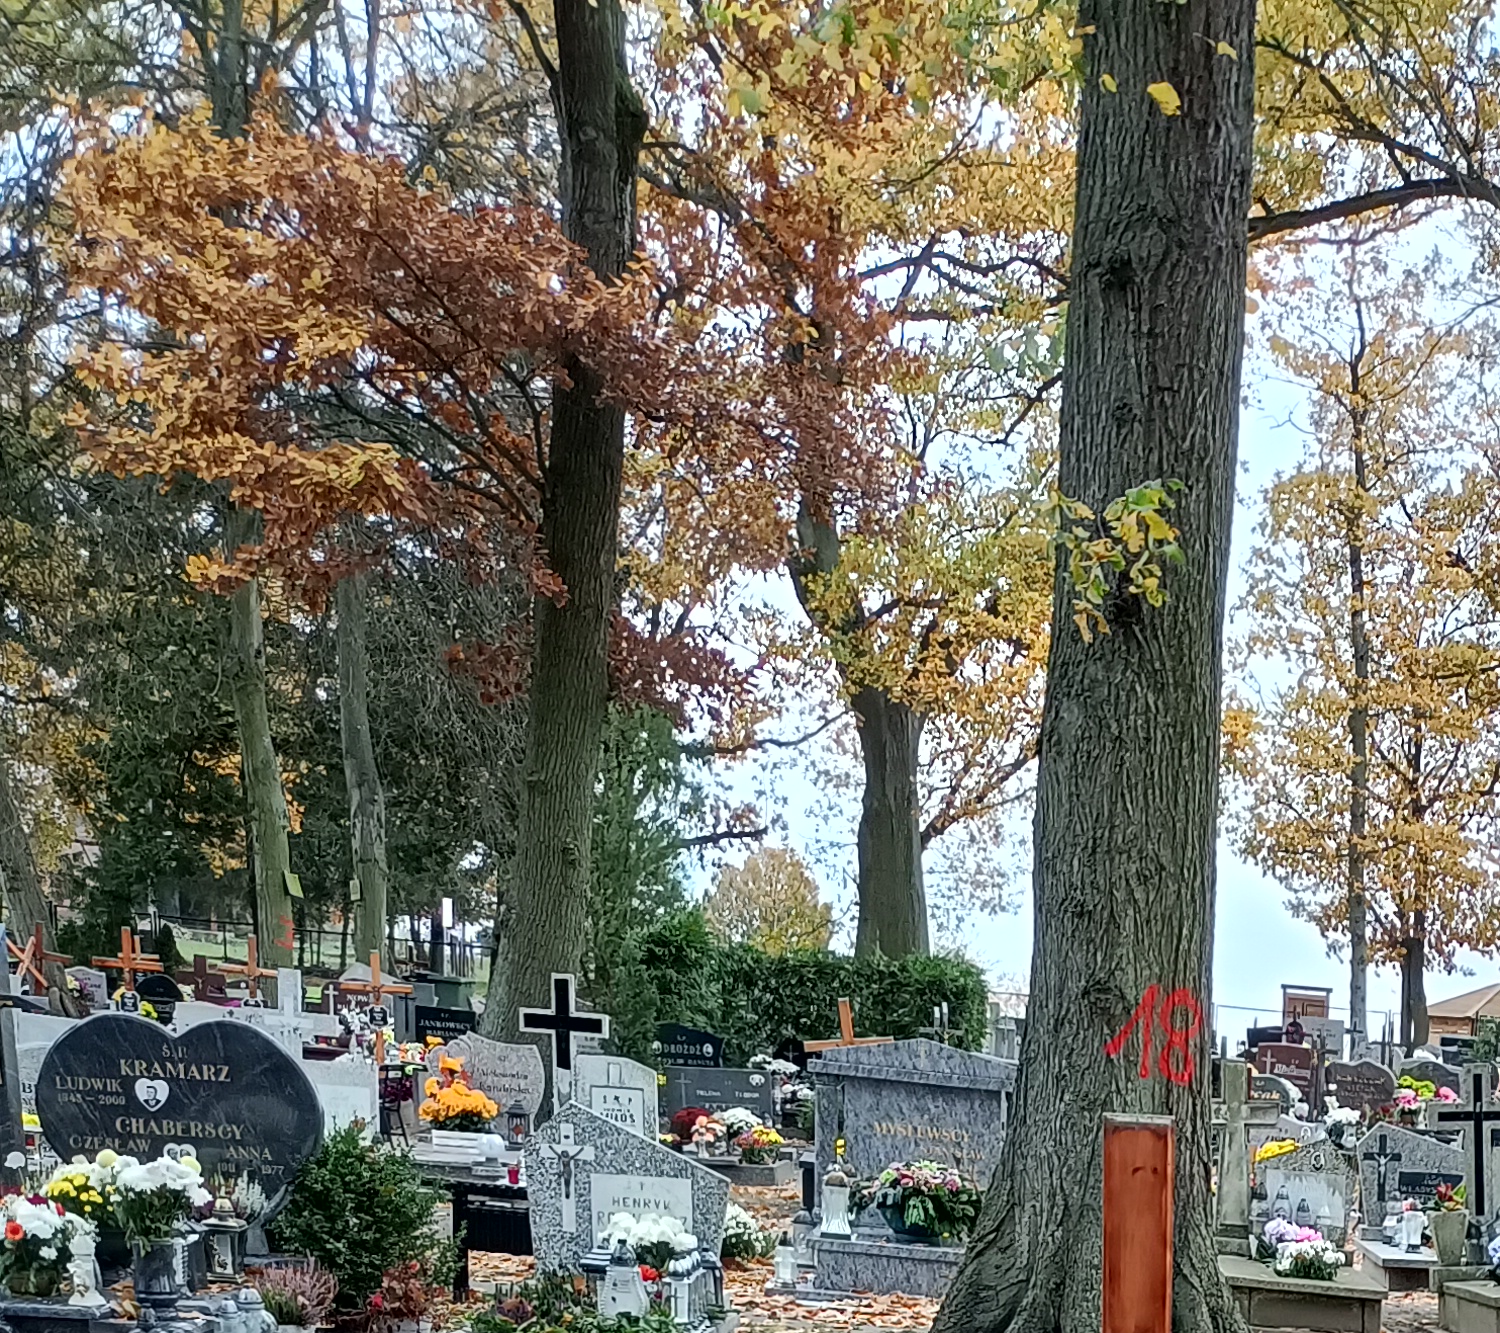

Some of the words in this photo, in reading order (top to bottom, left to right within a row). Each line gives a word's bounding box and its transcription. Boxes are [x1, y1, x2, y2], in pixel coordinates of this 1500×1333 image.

[1103, 983, 1201, 1086] 18
[120, 1058, 231, 1083] KRAMARZ
[55, 1074, 123, 1093] LUDWIK
[115, 1116, 244, 1141] CHABERSCY
[69, 1134, 152, 1153] CZESŁAW
[226, 1144, 273, 1162] ANNA
